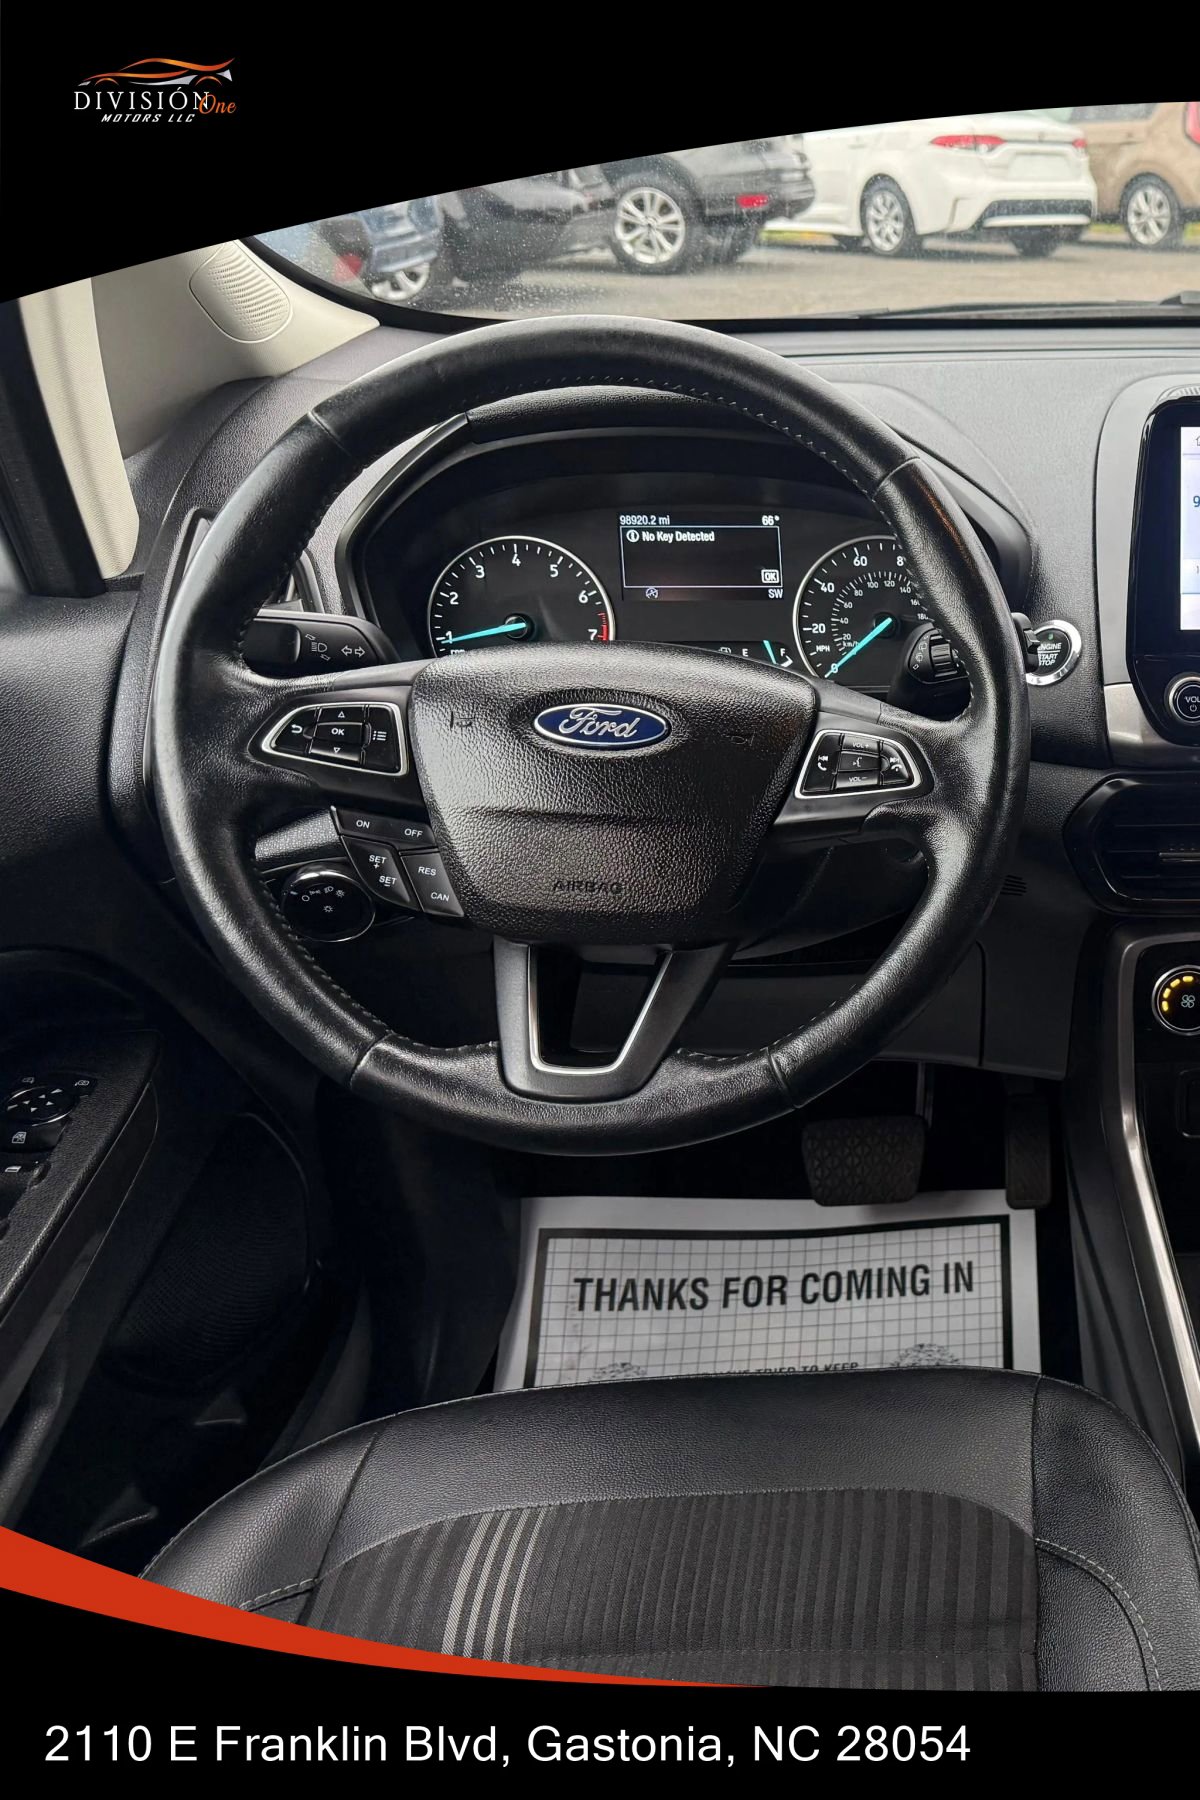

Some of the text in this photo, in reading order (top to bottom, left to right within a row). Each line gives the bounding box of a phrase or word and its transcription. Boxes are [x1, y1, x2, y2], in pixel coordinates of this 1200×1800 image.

[619, 515, 670, 525] 98920.2 mi
[642, 531, 715, 543] No Key Detected
[511, 554, 521, 566] 4
[853, 556, 868, 566] 60
[475, 565, 485, 578] 3
[550, 565, 559, 577] 5
[765, 573, 777, 581] OK
[820, 582, 835, 593] 40
[449, 592, 459, 605] 2
[579, 590, 589, 603] 6
[768, 589, 783, 598] SW
[812, 624, 826, 633] 20
[445, 631, 453, 644] 1
[587, 629, 598, 641] 7
[742, 649, 748, 657] E
[780, 649, 786, 657] F
[558, 707, 640, 738] Ford
[331, 728, 344, 736] OK
[356, 819, 370, 829] ON
[404, 828, 423, 837] OFF
[369, 854, 386, 863] SET
[418, 866, 437, 876] RES
[379, 875, 397, 885] SET
[553, 880, 624, 895] AIRBAG
[430, 892, 449, 901] CAN
[573, 1260, 974, 1312] THANKS FOR COMING IN
